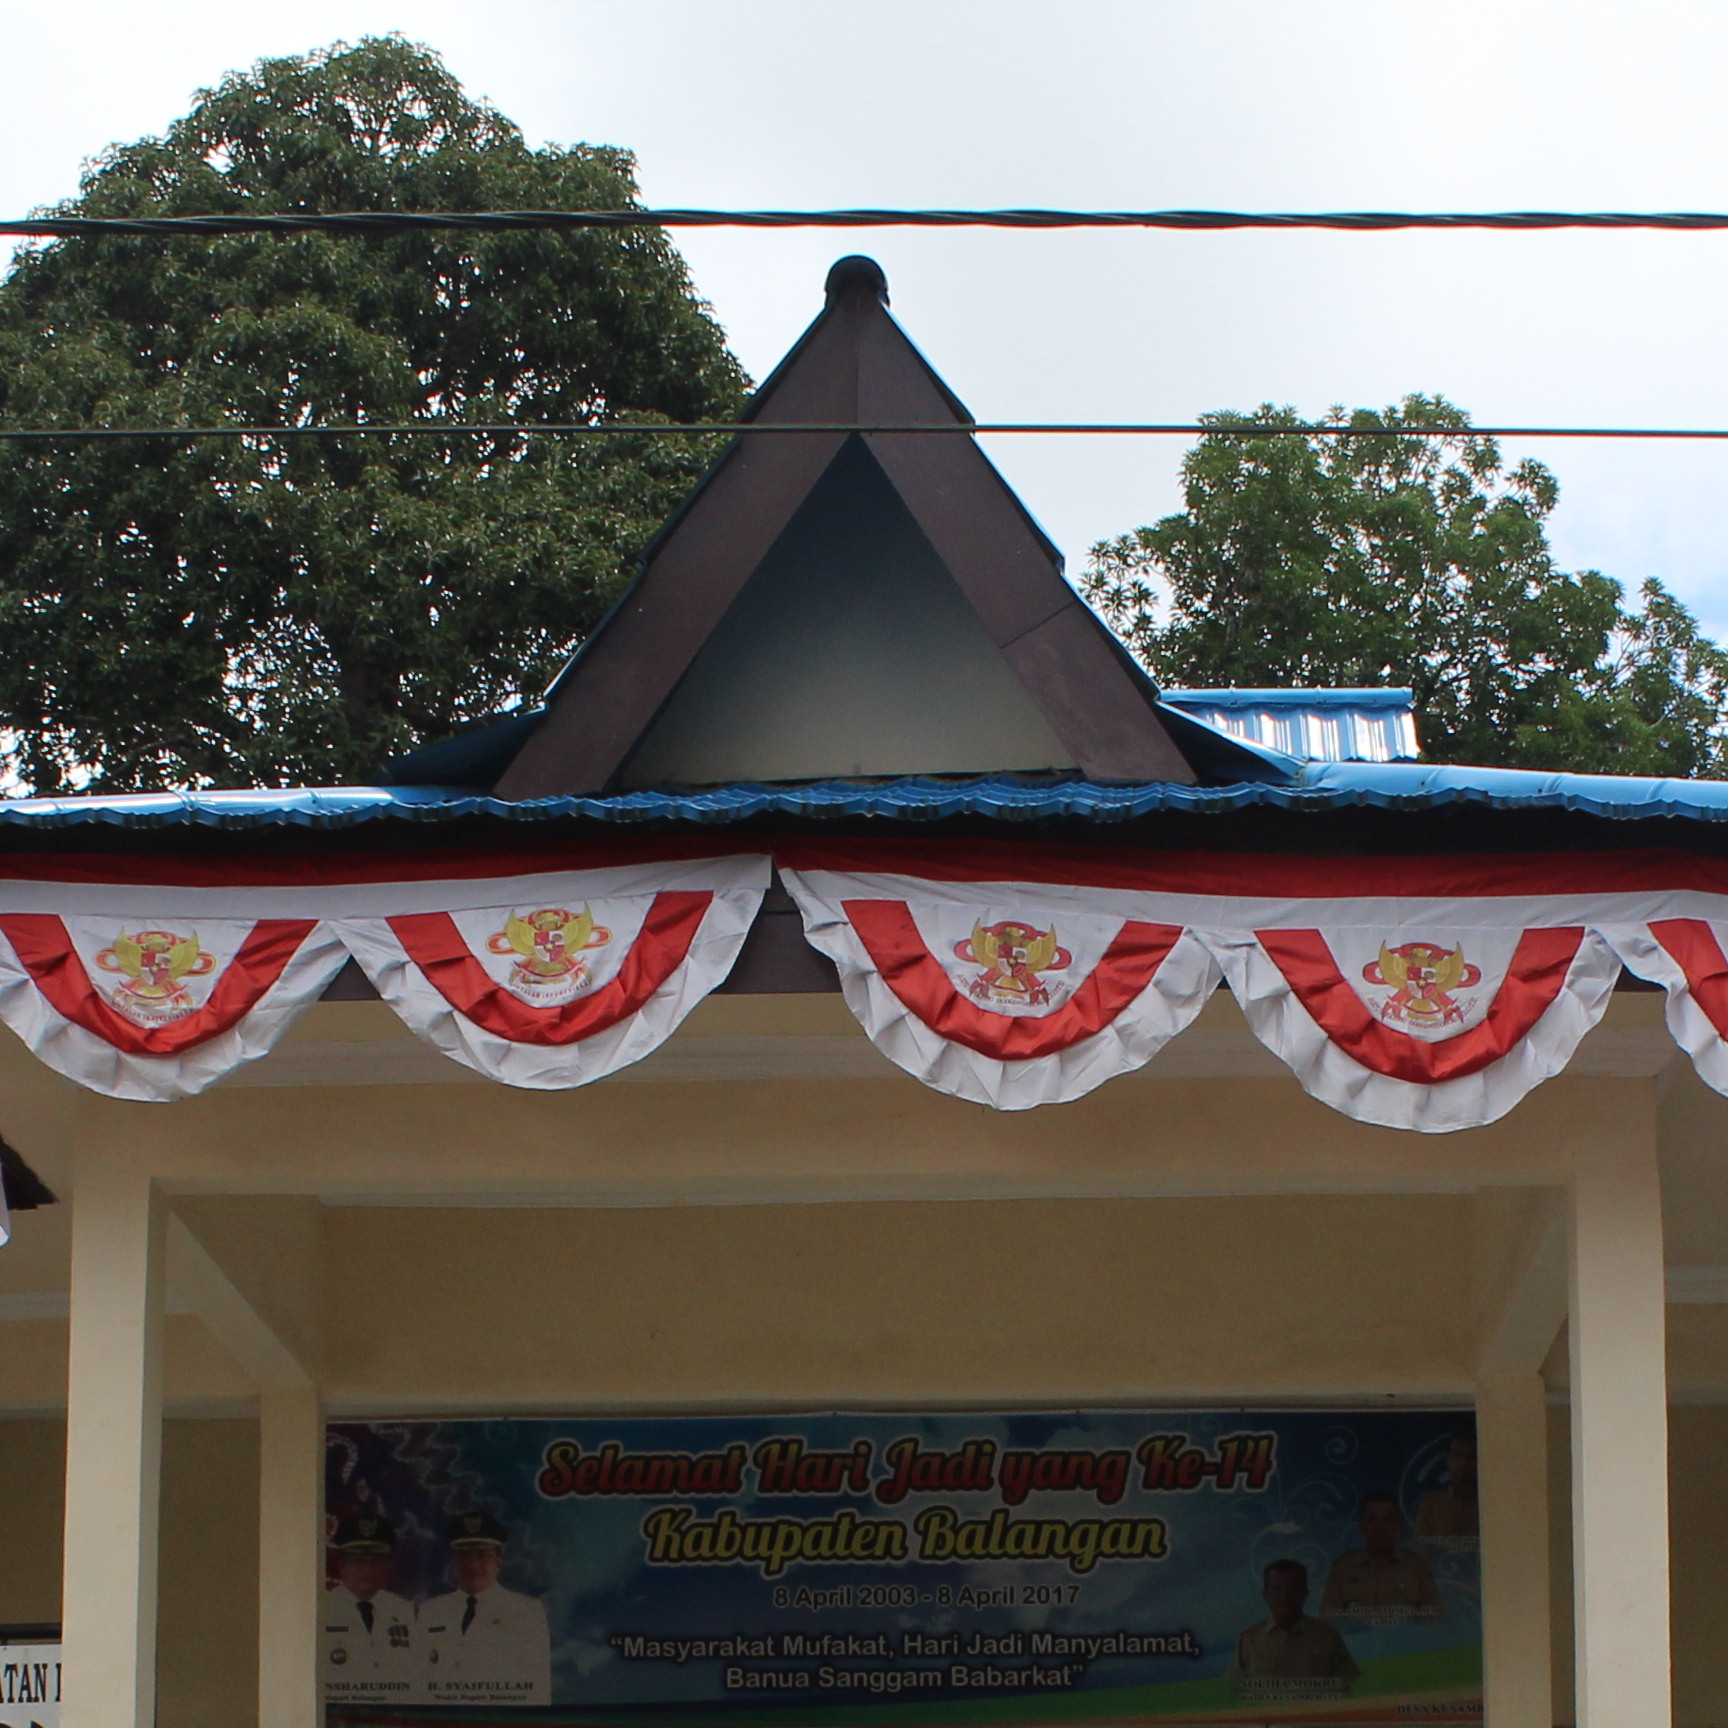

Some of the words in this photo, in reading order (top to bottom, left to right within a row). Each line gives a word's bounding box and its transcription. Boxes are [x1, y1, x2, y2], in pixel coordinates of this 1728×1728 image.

[541, 1441, 745, 1496] Selamat
[754, 1437, 871, 1495] Hari
[877, 1436, 997, 1503] Jadi
[1002, 1442, 1128, 1504] yang
[1137, 1433, 1274, 1490] Ke-14
[647, 1508, 906, 1575] Kabupaten
[917, 1507, 1167, 1573] Balangan
[775, 1587, 787, 1606] 8
[795, 1584, 852, 1609] April
[858, 1585, 917, 1606] 2003
[937, 1586, 950, 1605] 8
[958, 1583, 1016, 1609] April
[1022, 1585, 1080, 1605] 2017
[783, 1633, 895, 1659] Mufakat,
[903, 1634, 962, 1657] Hari
[967, 1633, 1027, 1656] Jadi
[1032, 1632, 1201, 1665] Manyalamat,
[727, 1668, 811, 1689] Banua
[819, 1667, 942, 1698] Sanggam
